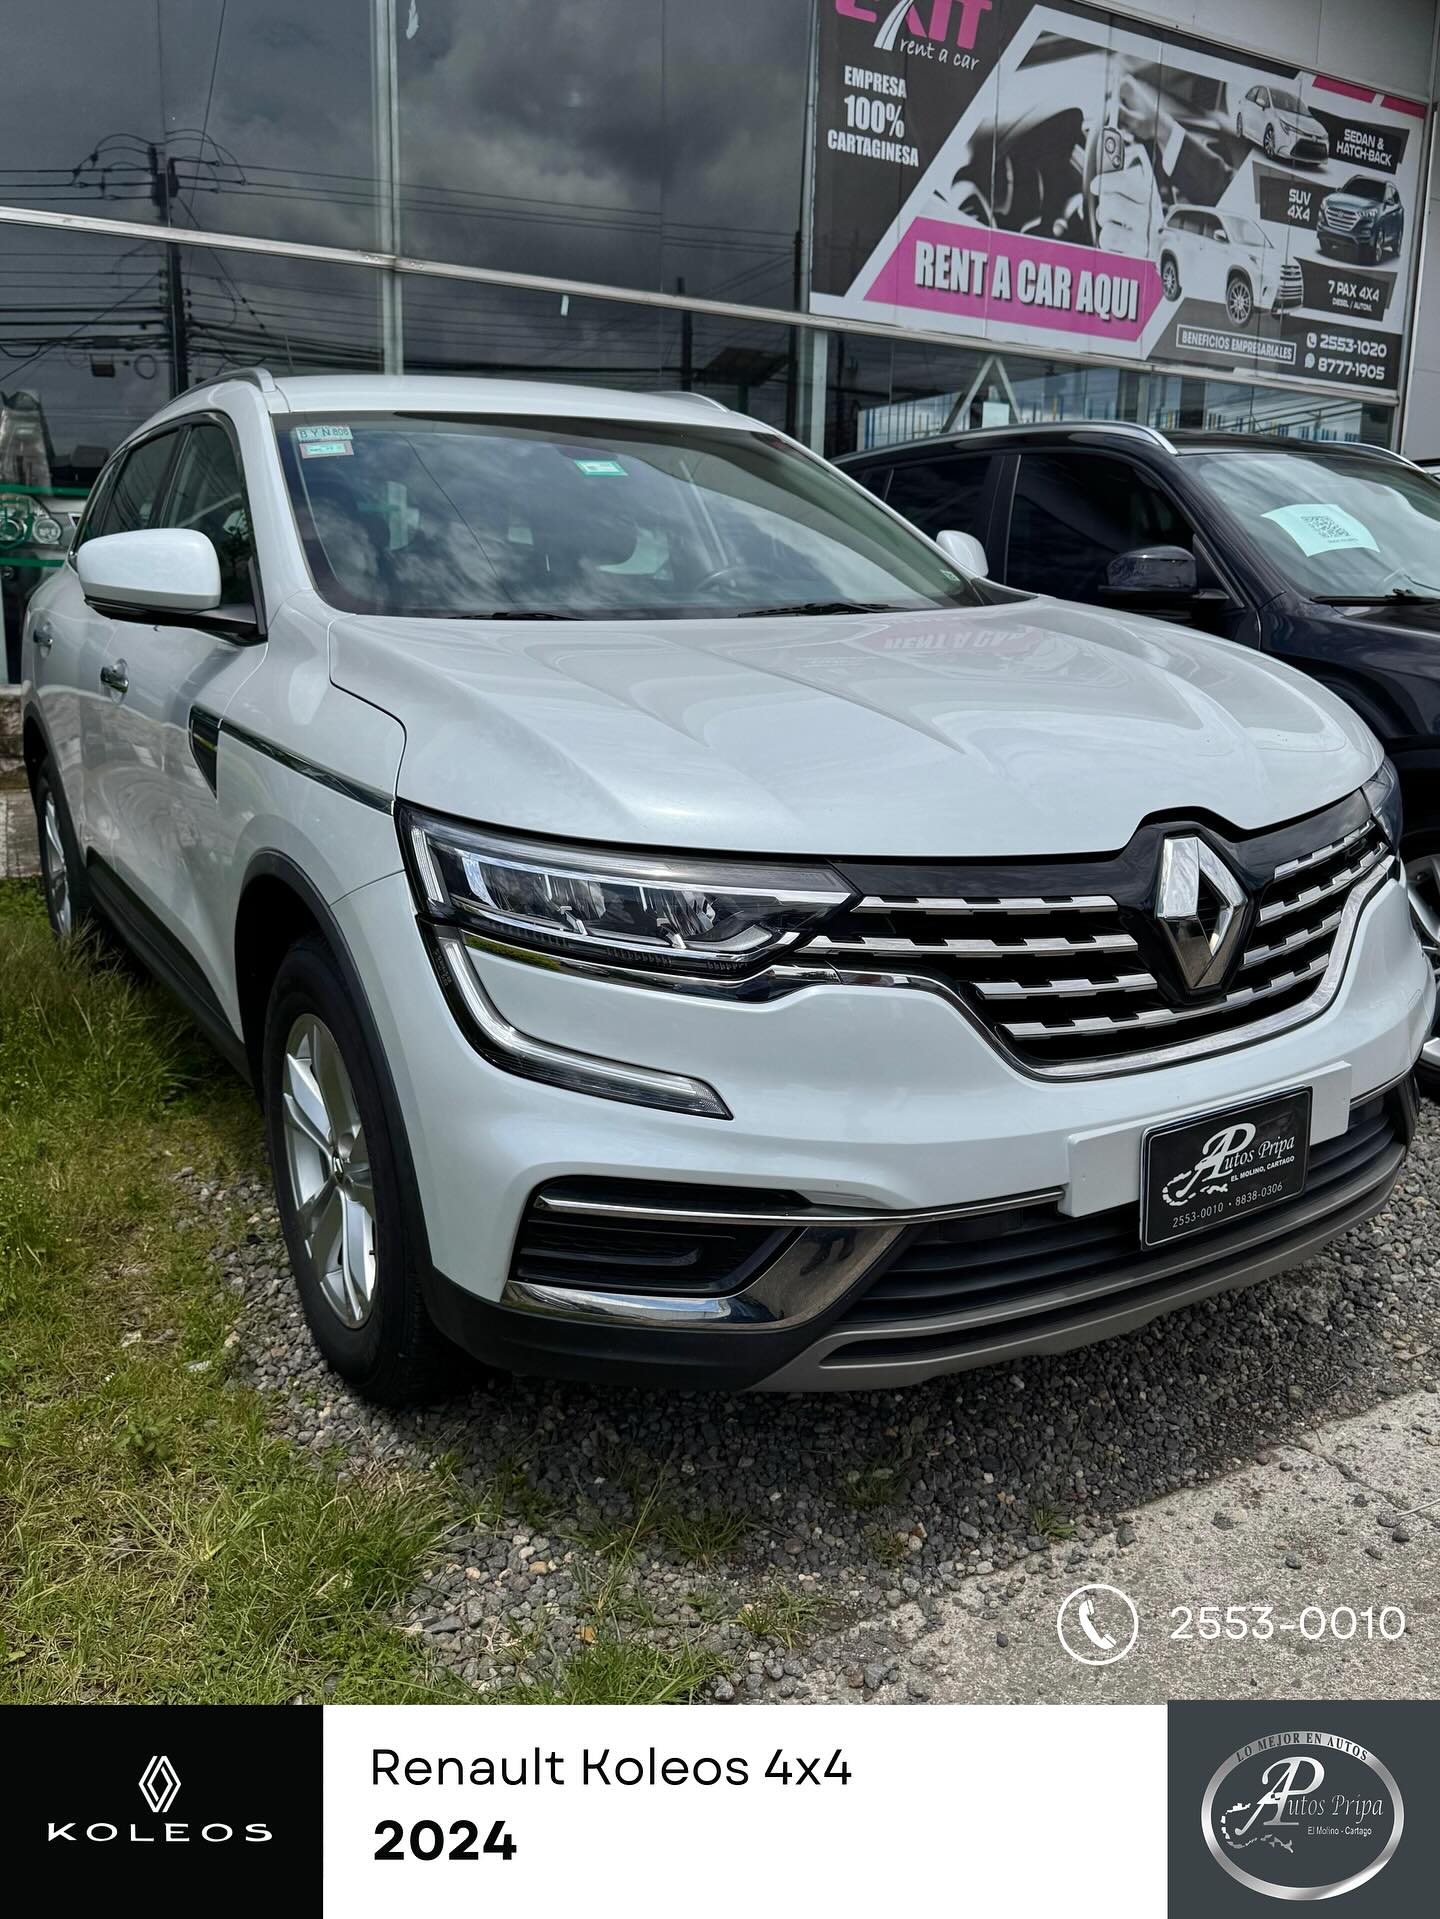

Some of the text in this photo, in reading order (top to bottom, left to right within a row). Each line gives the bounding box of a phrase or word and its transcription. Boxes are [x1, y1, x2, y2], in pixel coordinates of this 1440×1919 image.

[899, 38, 980, 71] rent a car
[844, 65, 907, 98] EMPRESA
[844, 94, 905, 139] 100%
[827, 129, 919, 168] CARTAGINESA
[1336, 140, 1392, 167] HATCH-BACK
[1343, 128, 1385, 151] SEDAN &
[1288, 188, 1312, 206] SUV
[1287, 204, 1311, 222] 4X4
[914, 240, 1140, 321] RENT A CAR AQUI
[1328, 279, 1380, 302] 7 PAX 4X4
[1182, 330, 1293, 360] BENEFICIOS EMPRESARIALES
[1257, 1135, 1296, 1160] Pripa
[1230, 1155, 1296, 1183] EL MOLINO, CARTAGO
[1171, 1180, 1284, 1229] 2553-0010 8838-0306
